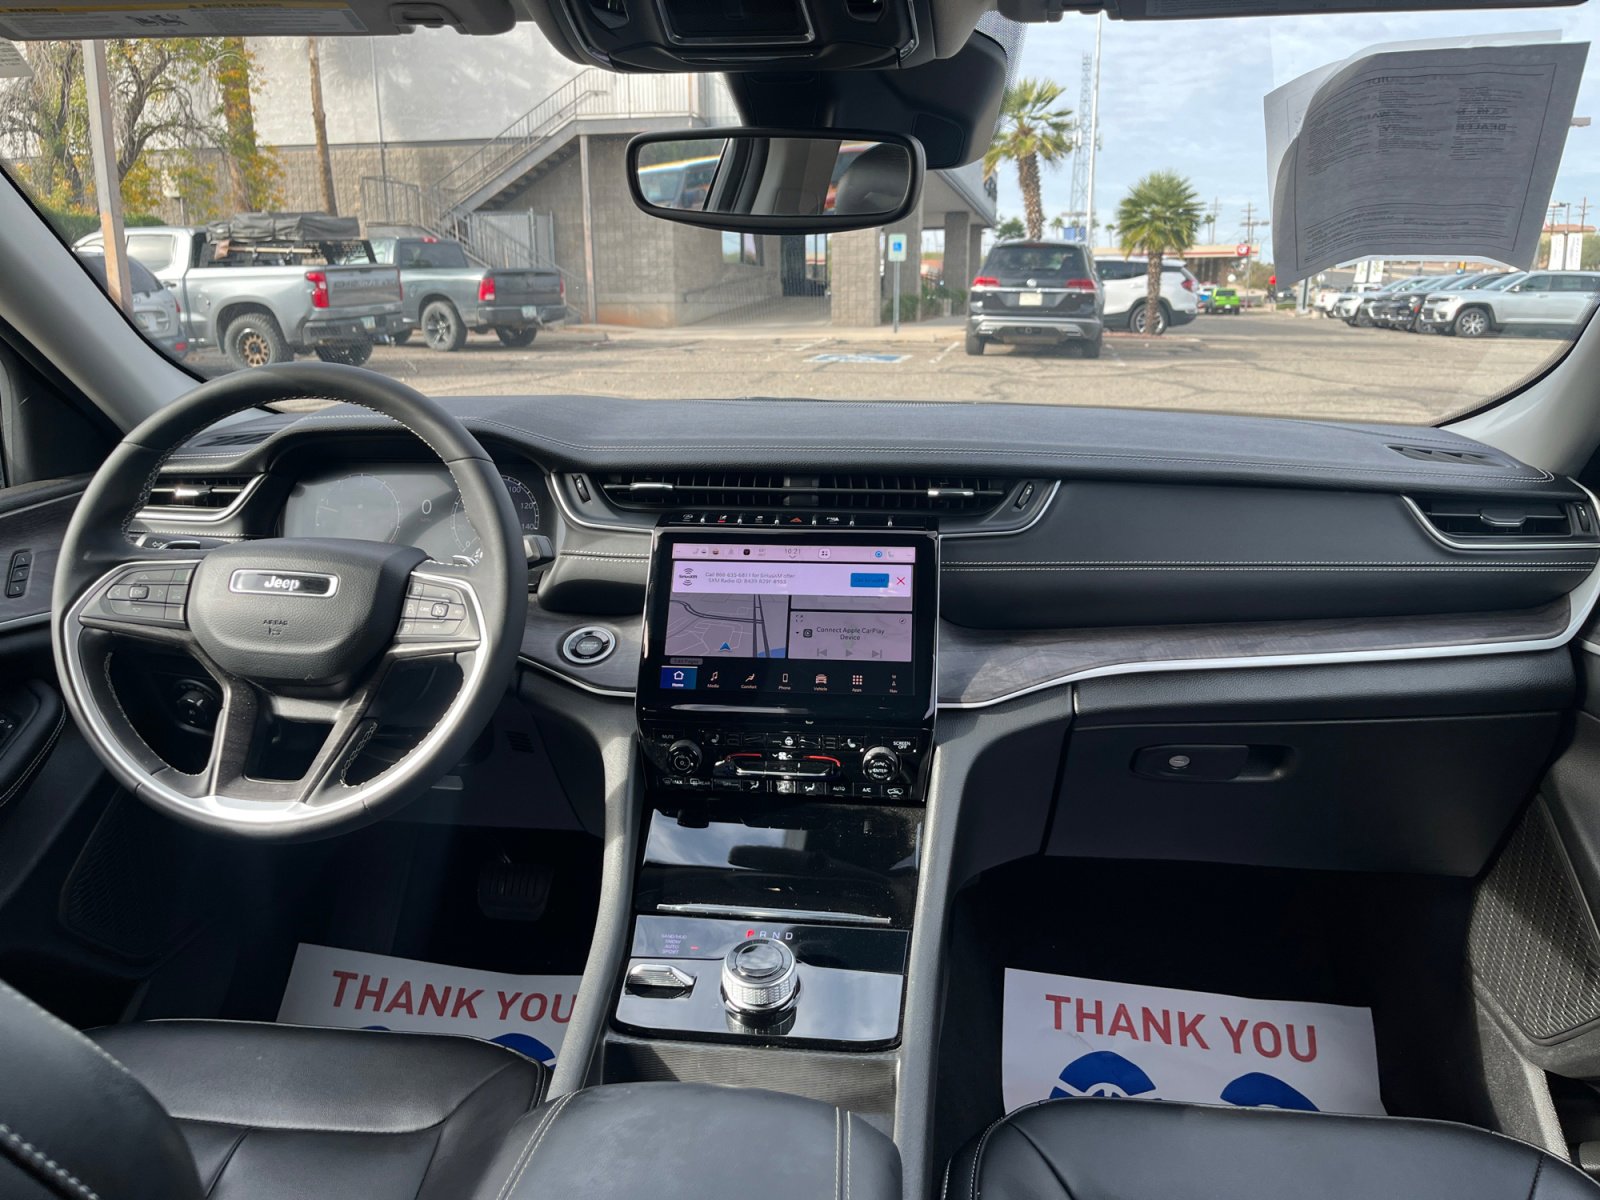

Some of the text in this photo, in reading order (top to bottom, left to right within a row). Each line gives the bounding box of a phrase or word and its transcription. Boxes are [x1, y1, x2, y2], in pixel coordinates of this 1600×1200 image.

[421, 499, 432, 515] 0
[264, 575, 300, 591] Jeep
[816, 626, 885, 636] Connect Apple CarPlay
[746, 929, 755, 938] P
[772, 931, 781, 940] N
[785, 931, 793, 941] D
[332, 969, 578, 1024] THANK YOU
[1045, 993, 1318, 1063] THANK YOU
